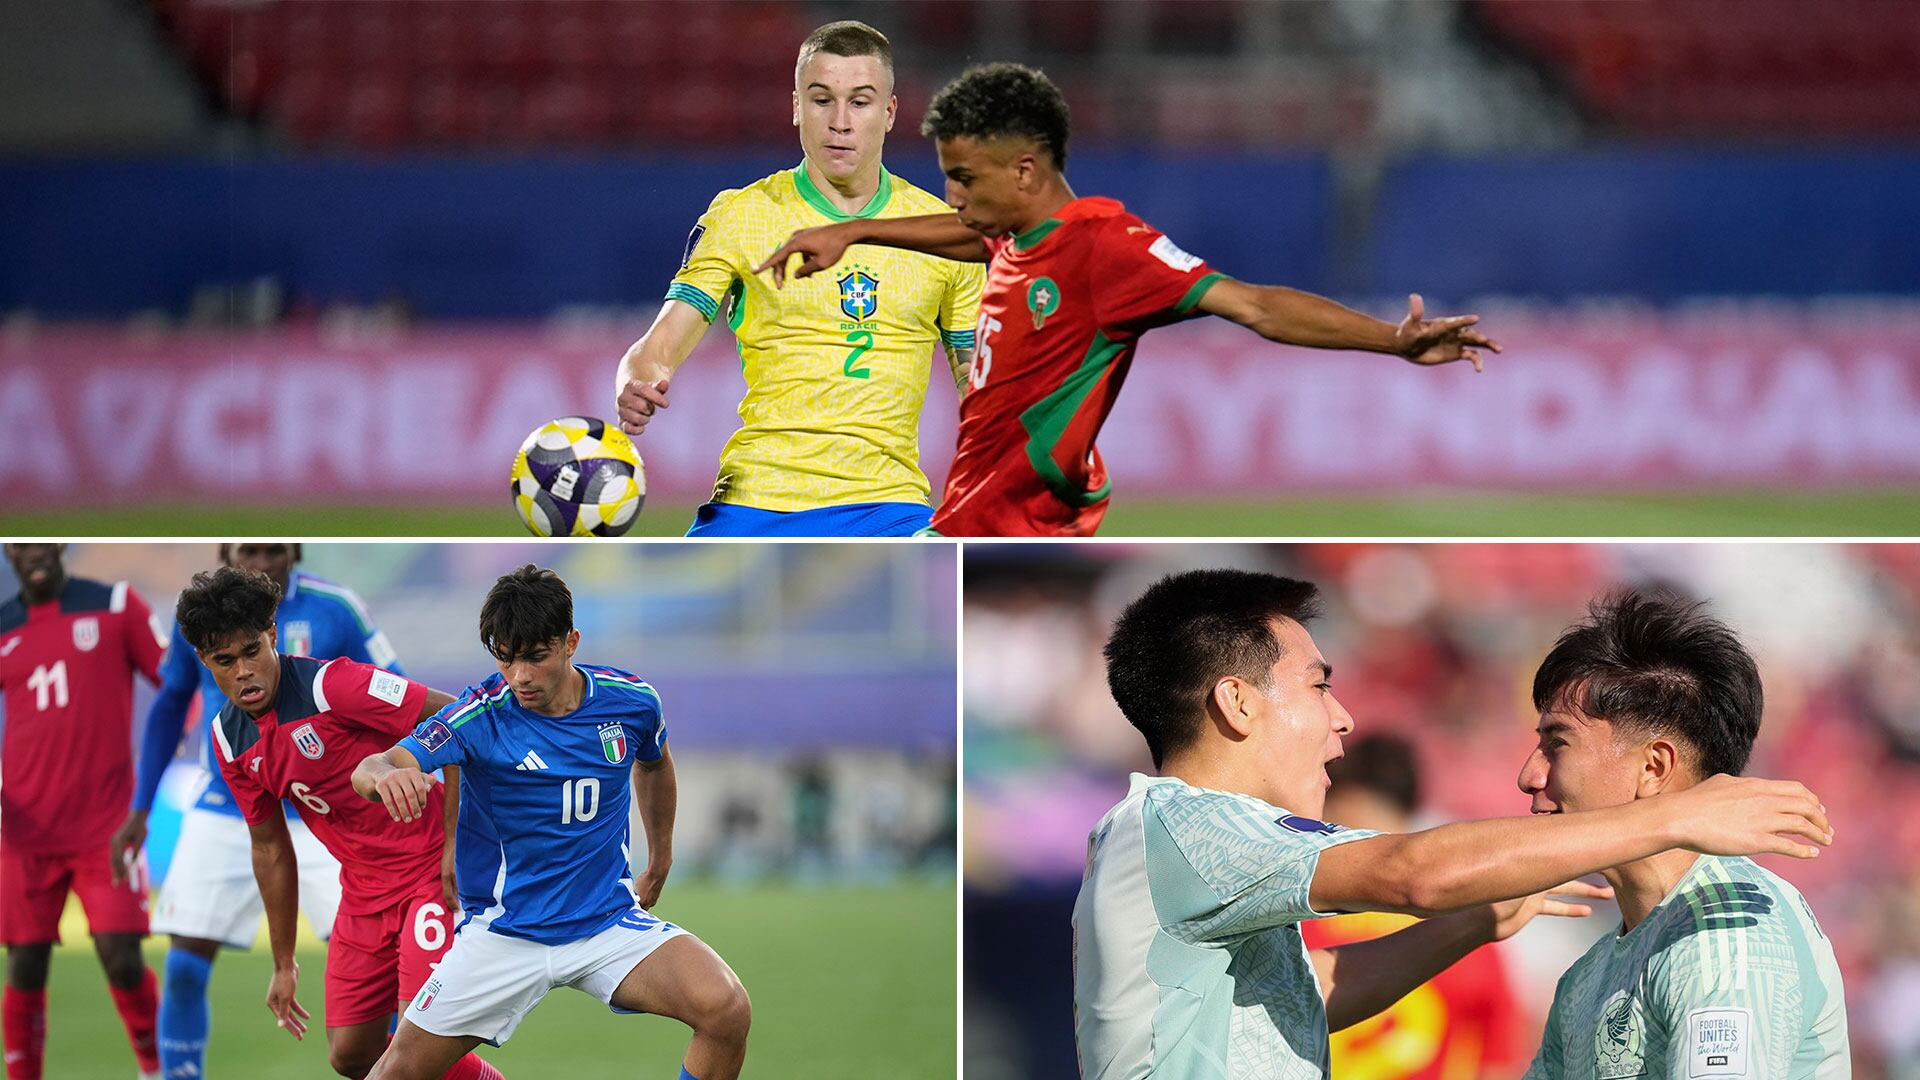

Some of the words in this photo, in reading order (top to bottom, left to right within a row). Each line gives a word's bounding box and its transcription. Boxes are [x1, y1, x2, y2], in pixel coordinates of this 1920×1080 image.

[850, 291, 866, 299] CBF
[843, 331, 874, 379] 2
[969, 311, 1003, 389] 15
[27, 659, 69, 711] 11
[601, 728, 622, 741] ITALIA
[290, 782, 331, 814] 6
[561, 778, 600, 825] 10
[414, 902, 446, 951] 6
[1699, 1019, 1737, 1029] FOOTBALL
[1699, 1029, 1738, 1043] UNITES
[1696, 1044, 1712, 1056] the
[1712, 1042, 1740, 1054] World
[1708, 1057, 1727, 1065] FIFA
